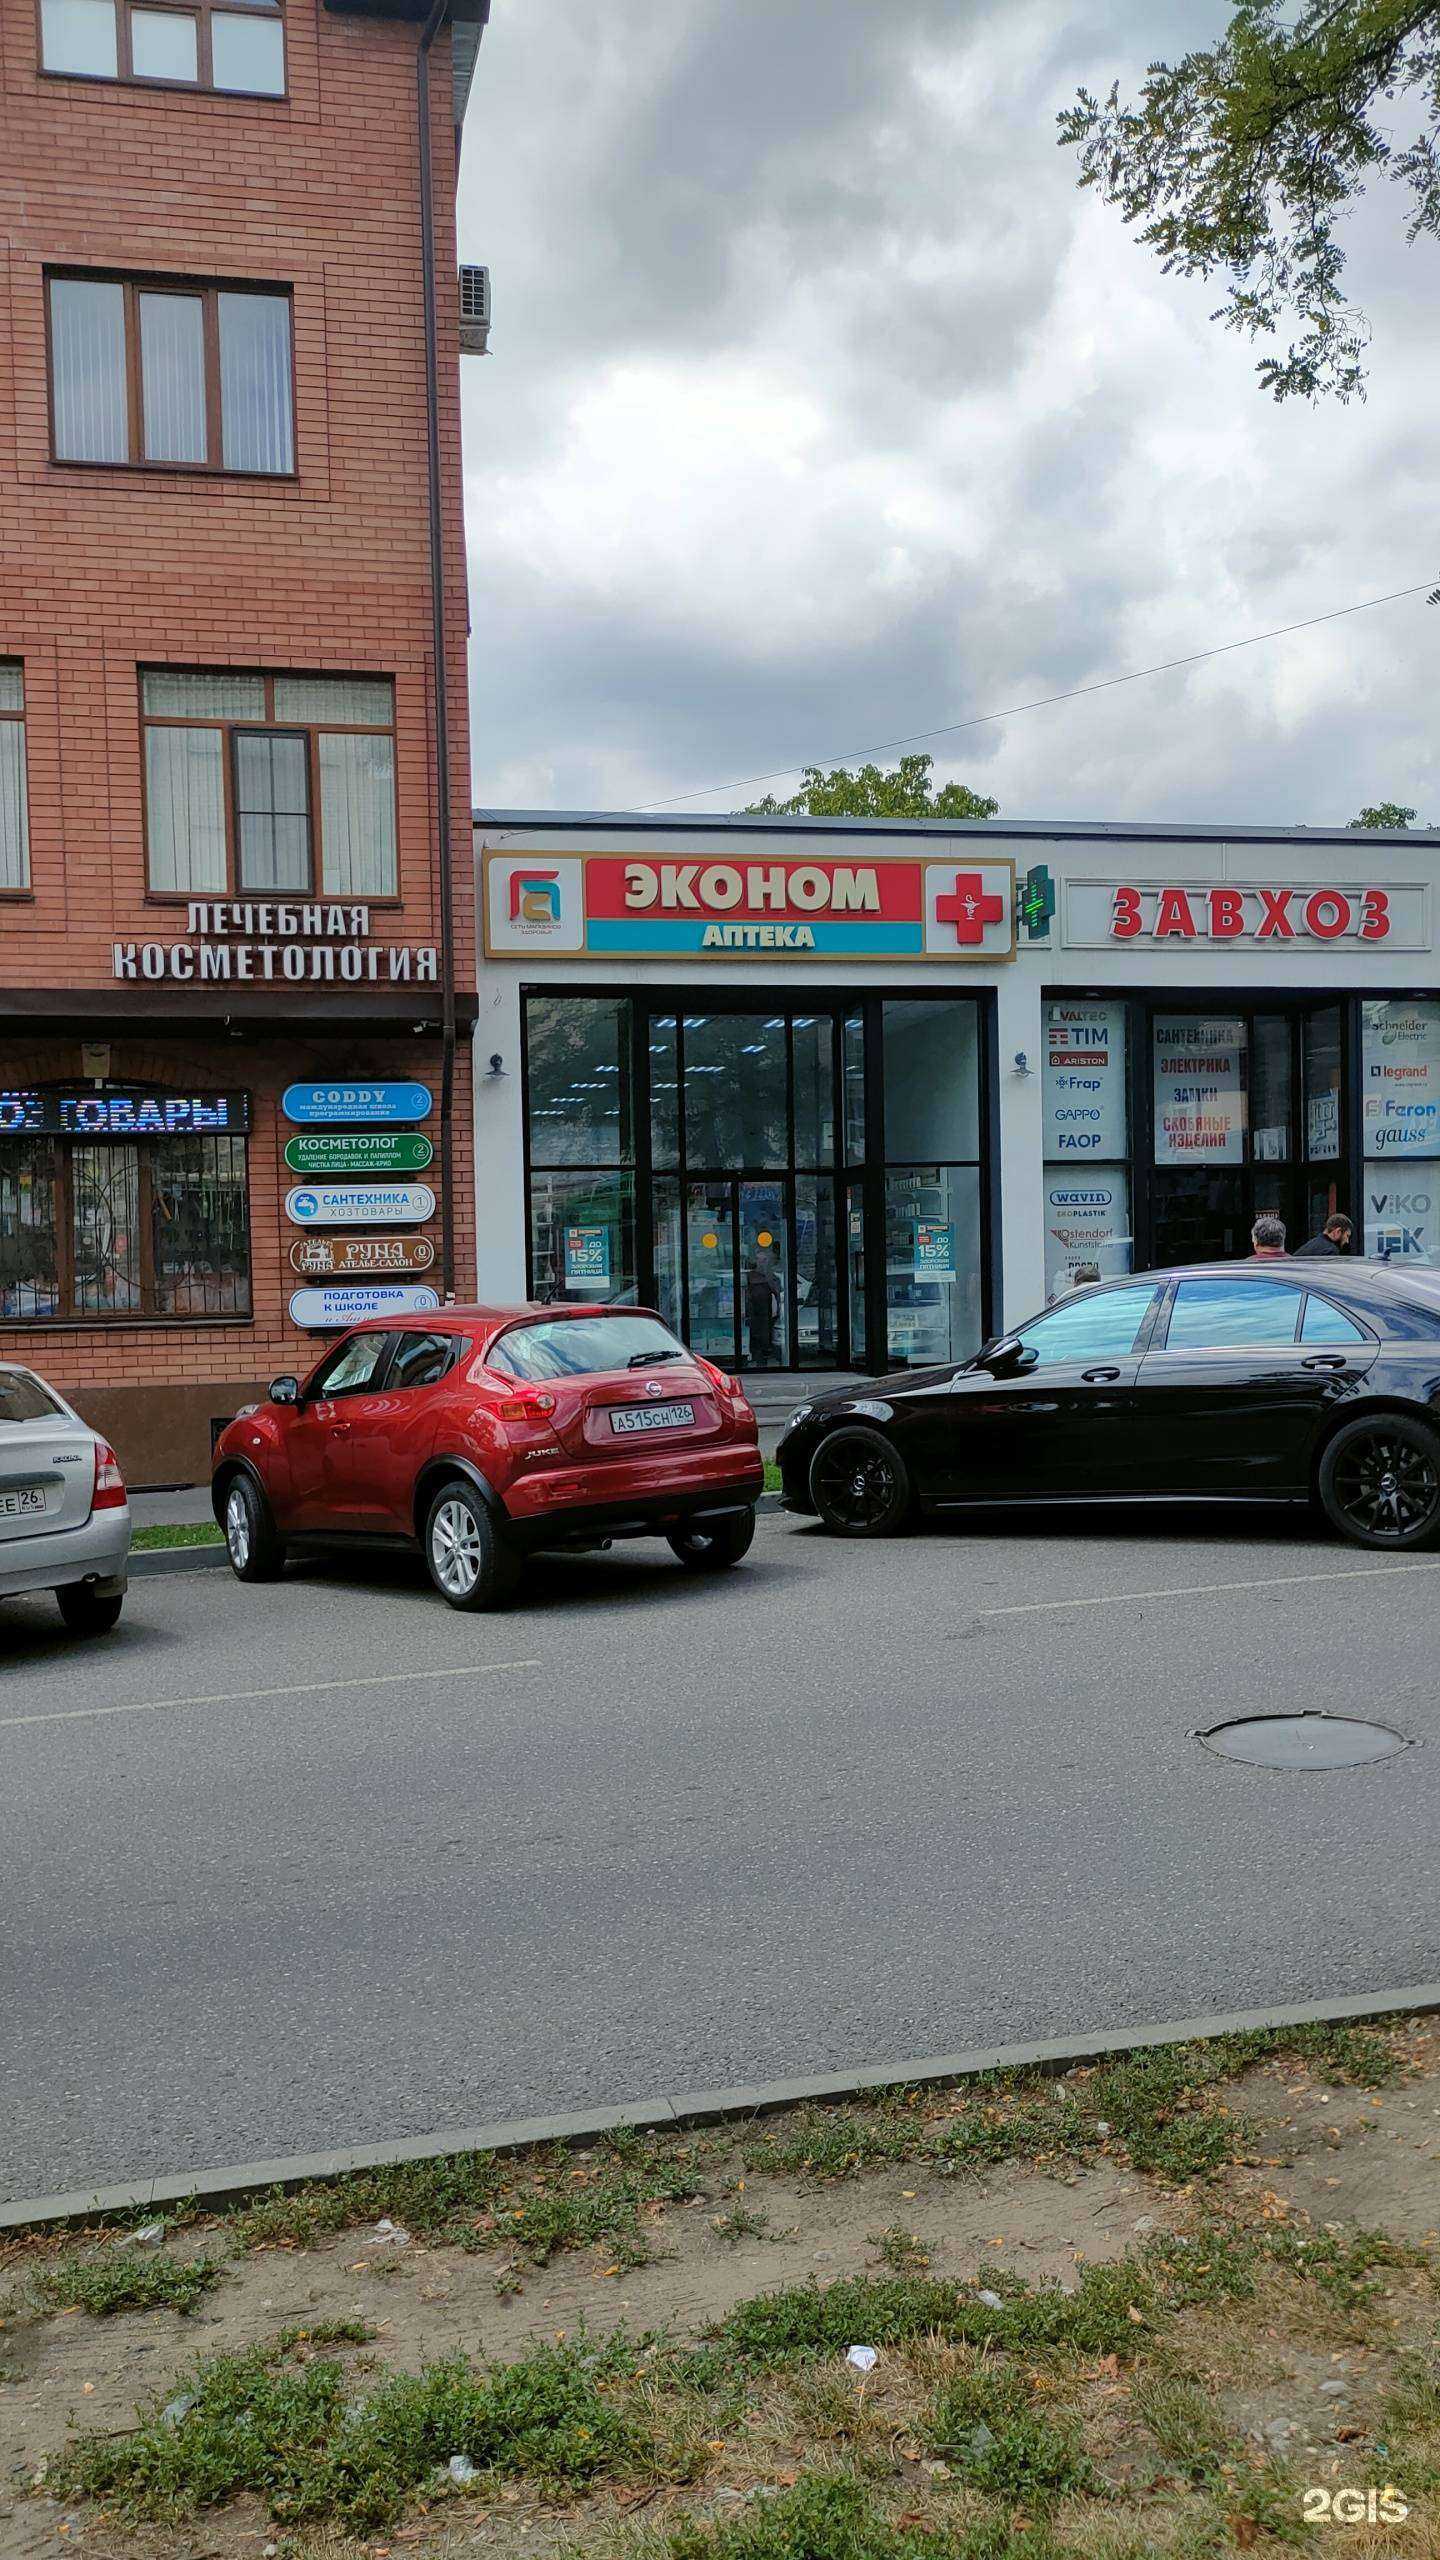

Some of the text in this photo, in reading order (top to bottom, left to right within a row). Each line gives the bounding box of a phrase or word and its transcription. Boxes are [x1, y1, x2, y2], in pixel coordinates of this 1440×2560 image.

[623, 863, 882, 913] ЭКОНОМ
[186, 902, 370, 936] ЛЕЧЕБНАЯ
[1110, 886, 1391, 940] ЗАВХОЗ
[702, 924, 817, 949] АПТЕКА
[113, 943, 438, 981] КОСМЕТОЛОГИЯ
[1371, 1020, 1428, 1031] Schneider
[1071, 1028, 1108, 1045] TIM
[1397, 1031, 1427, 1040] Electric
[1064, 1057, 1105, 1065] ARISTON
[1160, 1058, 1231, 1073] ЭЛЕКТРИКА
[1383, 1064, 1428, 1080] legrand
[1069, 1077, 1101, 1092] Frap
[312, 1090, 386, 1103] CODDY
[416, 1094, 423, 1104] 2
[1055, 1109, 1100, 1120] GAPPO
[1385, 1100, 1437, 1117] Feron
[1163, 1116, 1231, 1131] СКОБЯНЫЕ
[299, 1137, 399, 1150] КОСМЕТОЛОГ
[1058, 1134, 1101, 1148] FAOP
[1168, 1133, 1226, 1148] ИЗДЕЛИЯ
[1375, 1128, 1426, 1150] gauss
[417, 1144, 424, 1154] 2
[322, 1193, 410, 1205] САНТЕХНИКА
[1057, 1193, 1106, 1202] wavin
[329, 1207, 403, 1217] ХОЗТОВАРЫ
[1057, 1210, 1107, 1218] EKOPLASTIK
[1061, 1228, 1113, 1239] Ostendorf
[345, 1242, 406, 1260] РУНА
[570, 1249, 603, 1263] 15%
[919, 1244, 950, 1257] 15%
[301, 1260, 336, 1271] РУНА
[338, 1258, 413, 1269] АТЕЛЬЕ-САЛОН
[324, 1290, 404, 1301] ПОДГОТОВКА
[324, 1302, 378, 1311] К ШКОЛЕ
[671, 1406, 691, 1419] 126
[525, 1448, 560, 1460] JUKE
[21, 1490, 39, 1505] 26
